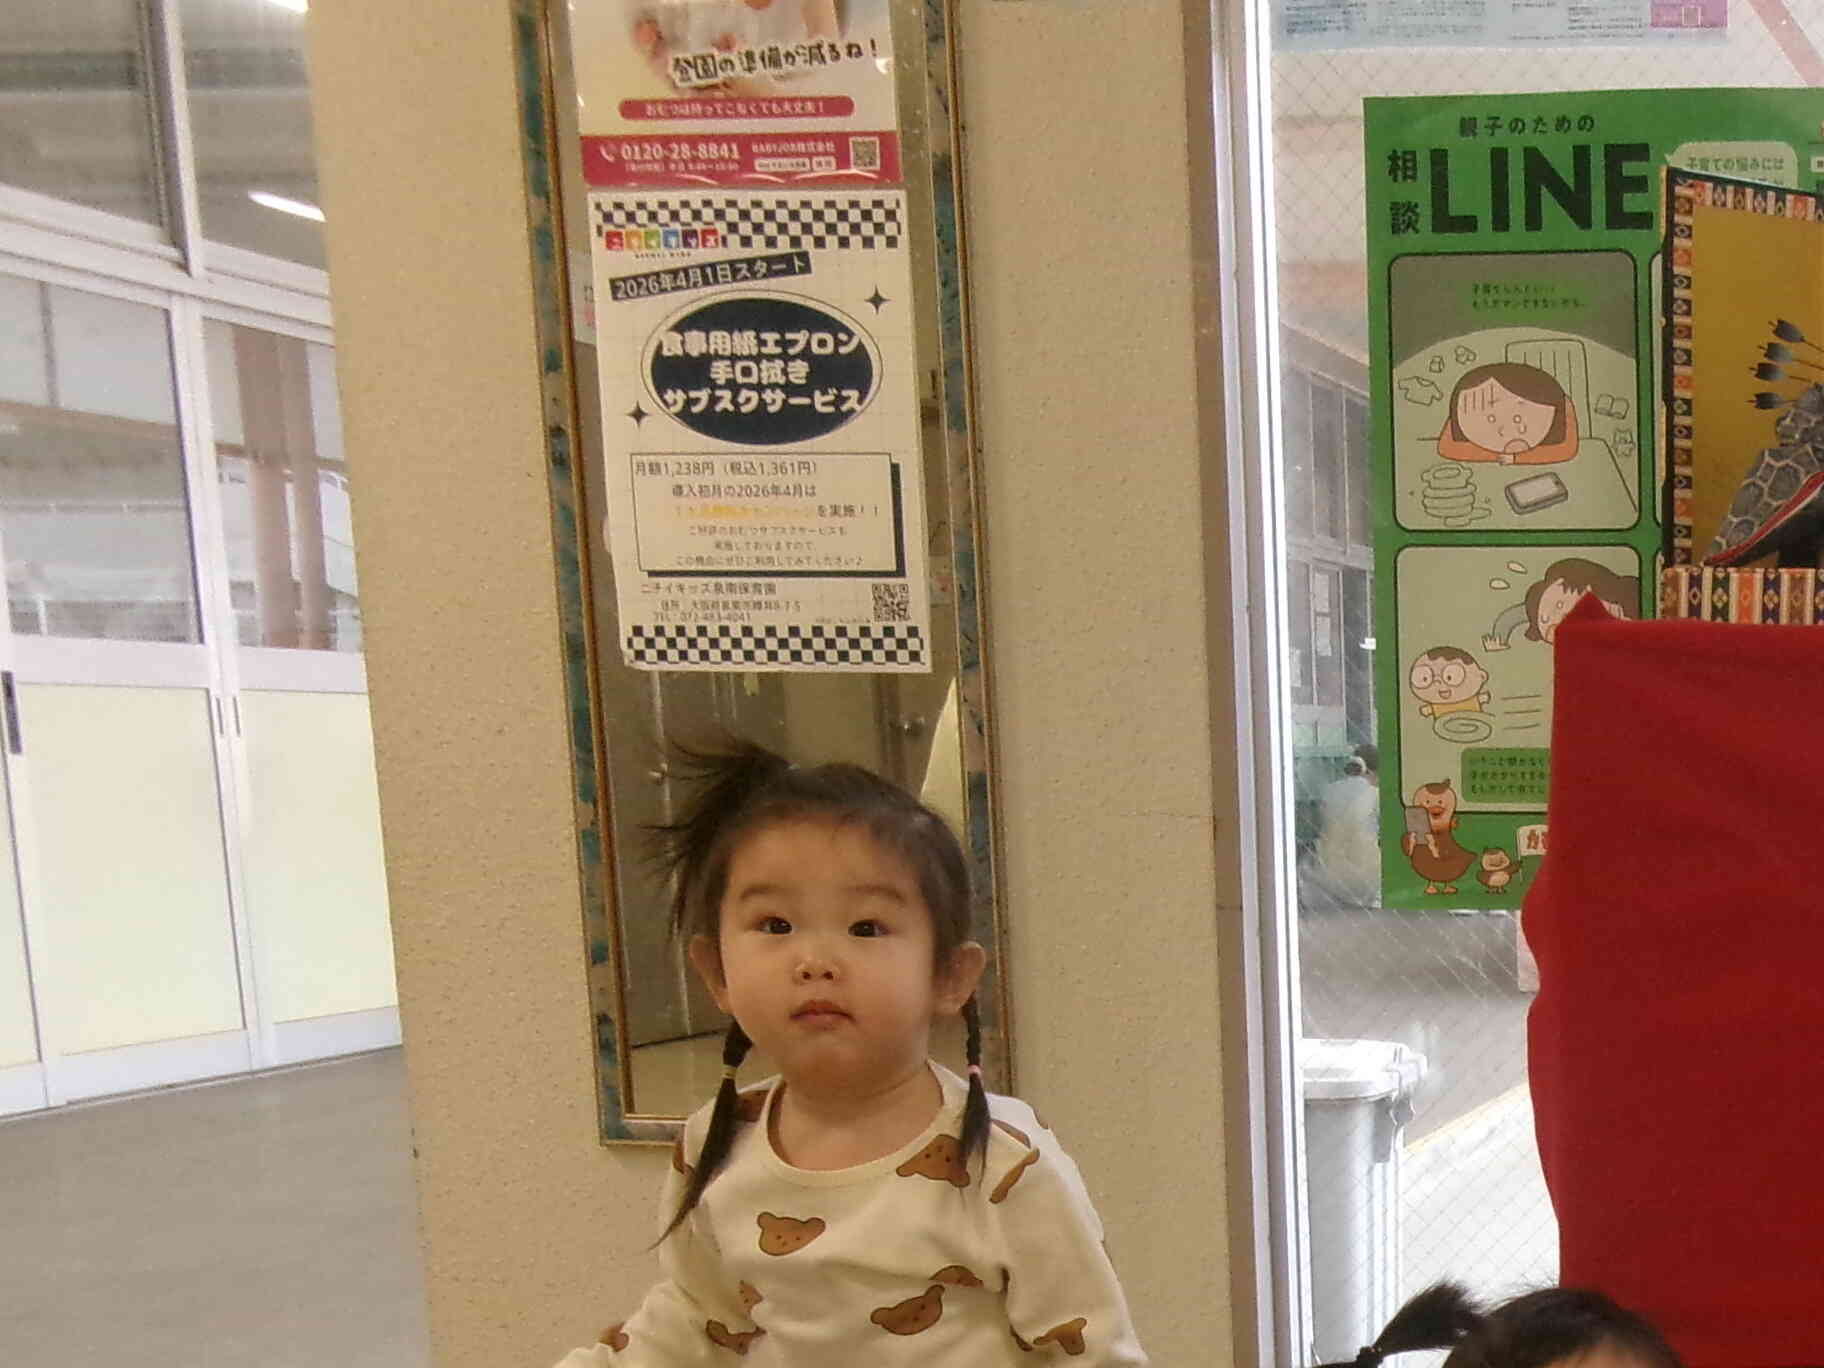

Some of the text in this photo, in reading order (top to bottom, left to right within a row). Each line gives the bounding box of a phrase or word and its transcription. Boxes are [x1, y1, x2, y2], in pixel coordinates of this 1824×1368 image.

[1460, 114, 1595, 138] 親子のための
[1388, 149, 1420, 235] 相談
[1430, 143, 1654, 234] LINE
[616, 255, 805, 299] 2026年4月1日スタート
[661, 329, 861, 356] 食事用紙エプロン
[710, 359, 811, 385] 手口拭き
[664, 387, 861, 414] サブスクサービス
